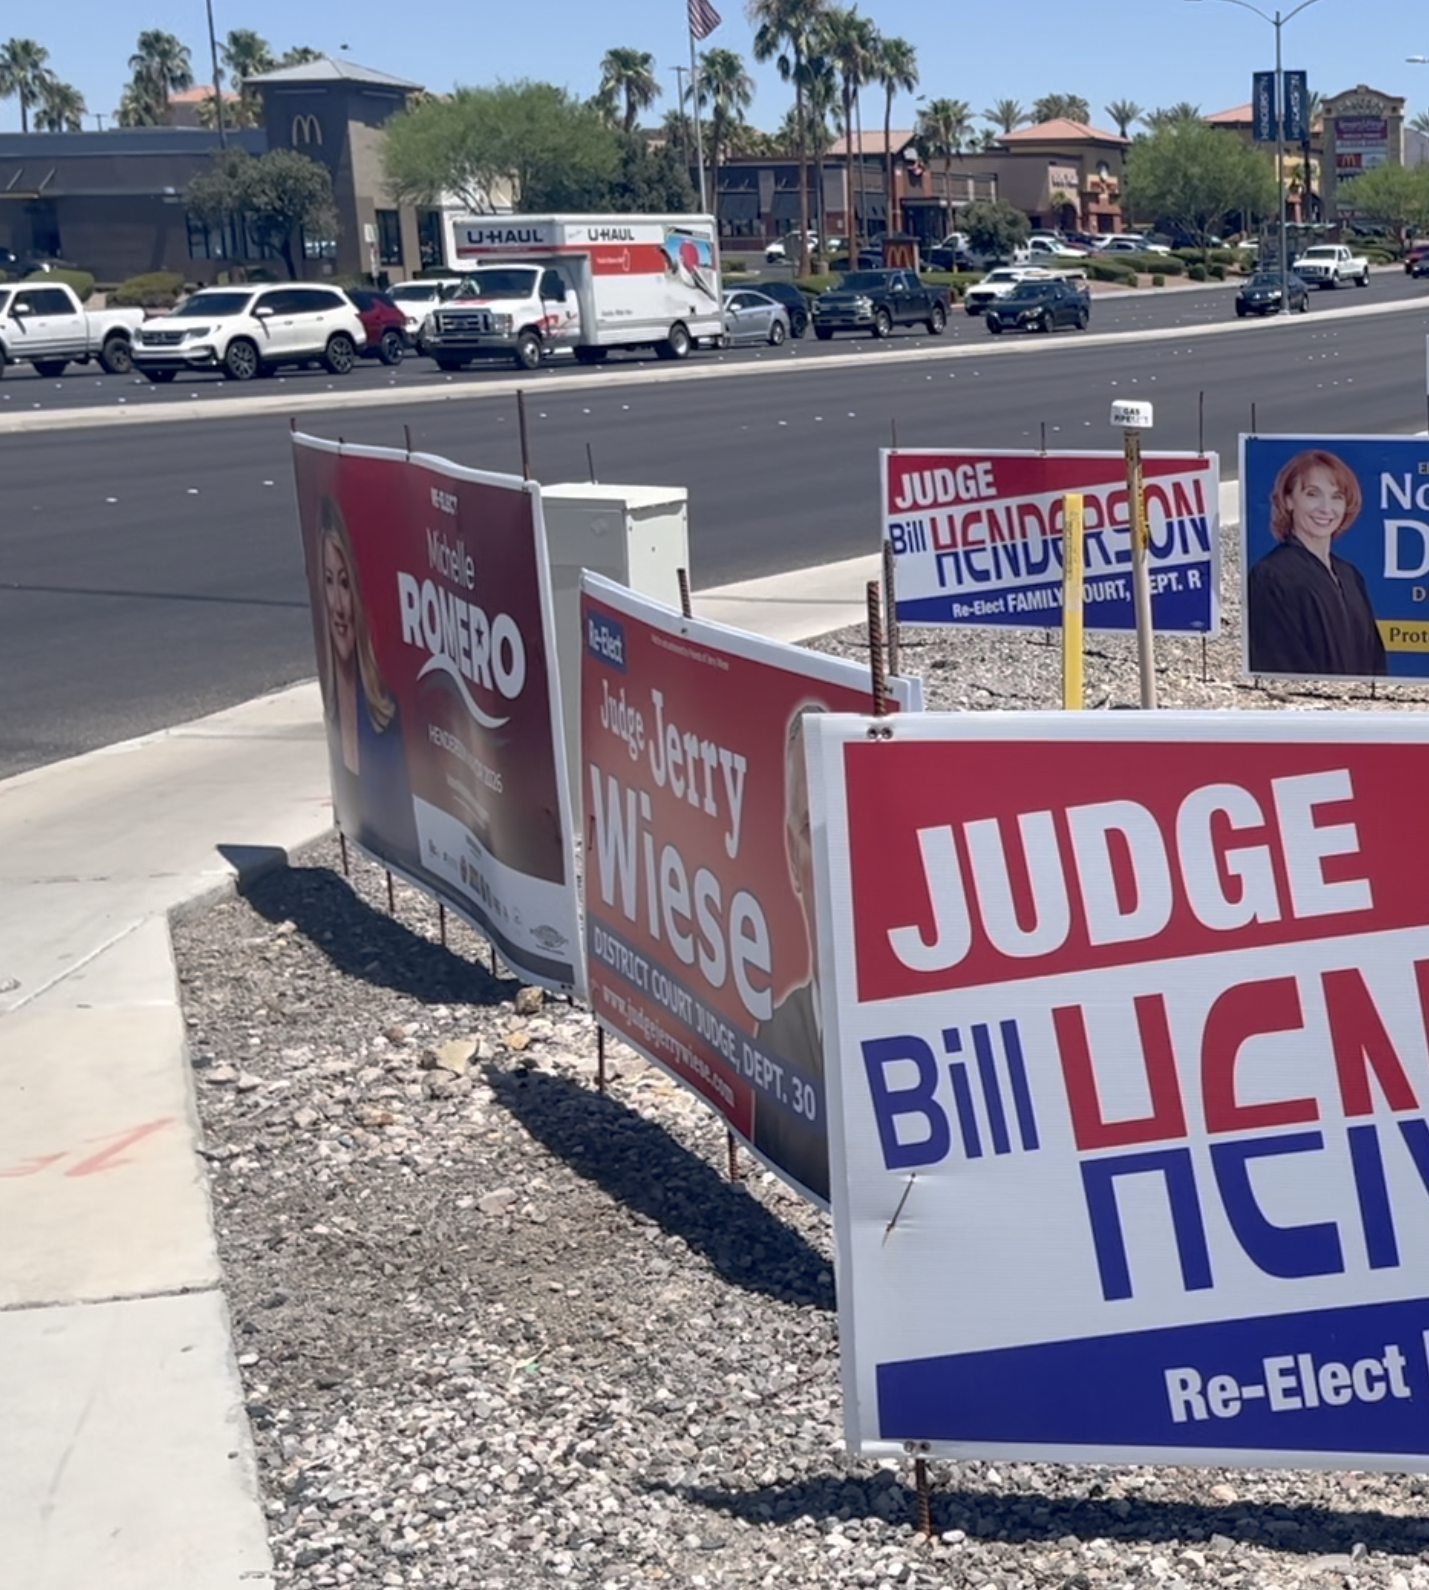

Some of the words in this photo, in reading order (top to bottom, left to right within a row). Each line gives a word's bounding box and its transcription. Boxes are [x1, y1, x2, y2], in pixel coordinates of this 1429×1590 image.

[467, 229, 543, 244] U-HAUL
[588, 228, 635, 241] U-HAUL
[894, 461, 997, 509] JUDGE
[426, 528, 475, 590] Michelle
[888, 519, 927, 555] Bill
[952, 598, 1005, 619] Re-Elect
[1083, 579, 1131, 602] OURT,
[1150, 572, 1183, 595] EPT.
[1187, 569, 1202, 589] R
[397, 571, 526, 699] ROMERO
[588, 618, 624, 665] Re-Elect
[600, 678, 645, 761] Judge
[649, 688, 748, 859] Jerry
[589, 762, 773, 1021] Wiese
[886, 768, 1374, 972] JUDGE
[594, 925, 649, 991] DISTRICT
[652, 969, 694, 1026] COURT
[695, 1003, 740, 1074] JUDGE,
[742, 1042, 788, 1104] DEPT.
[792, 1075, 816, 1121] 30
[602, 985, 735, 1109] www.judgejerrywiese.com
[860, 1019, 1040, 1170] Bill
[1164, 1344, 1410, 1424] Re-Elect
